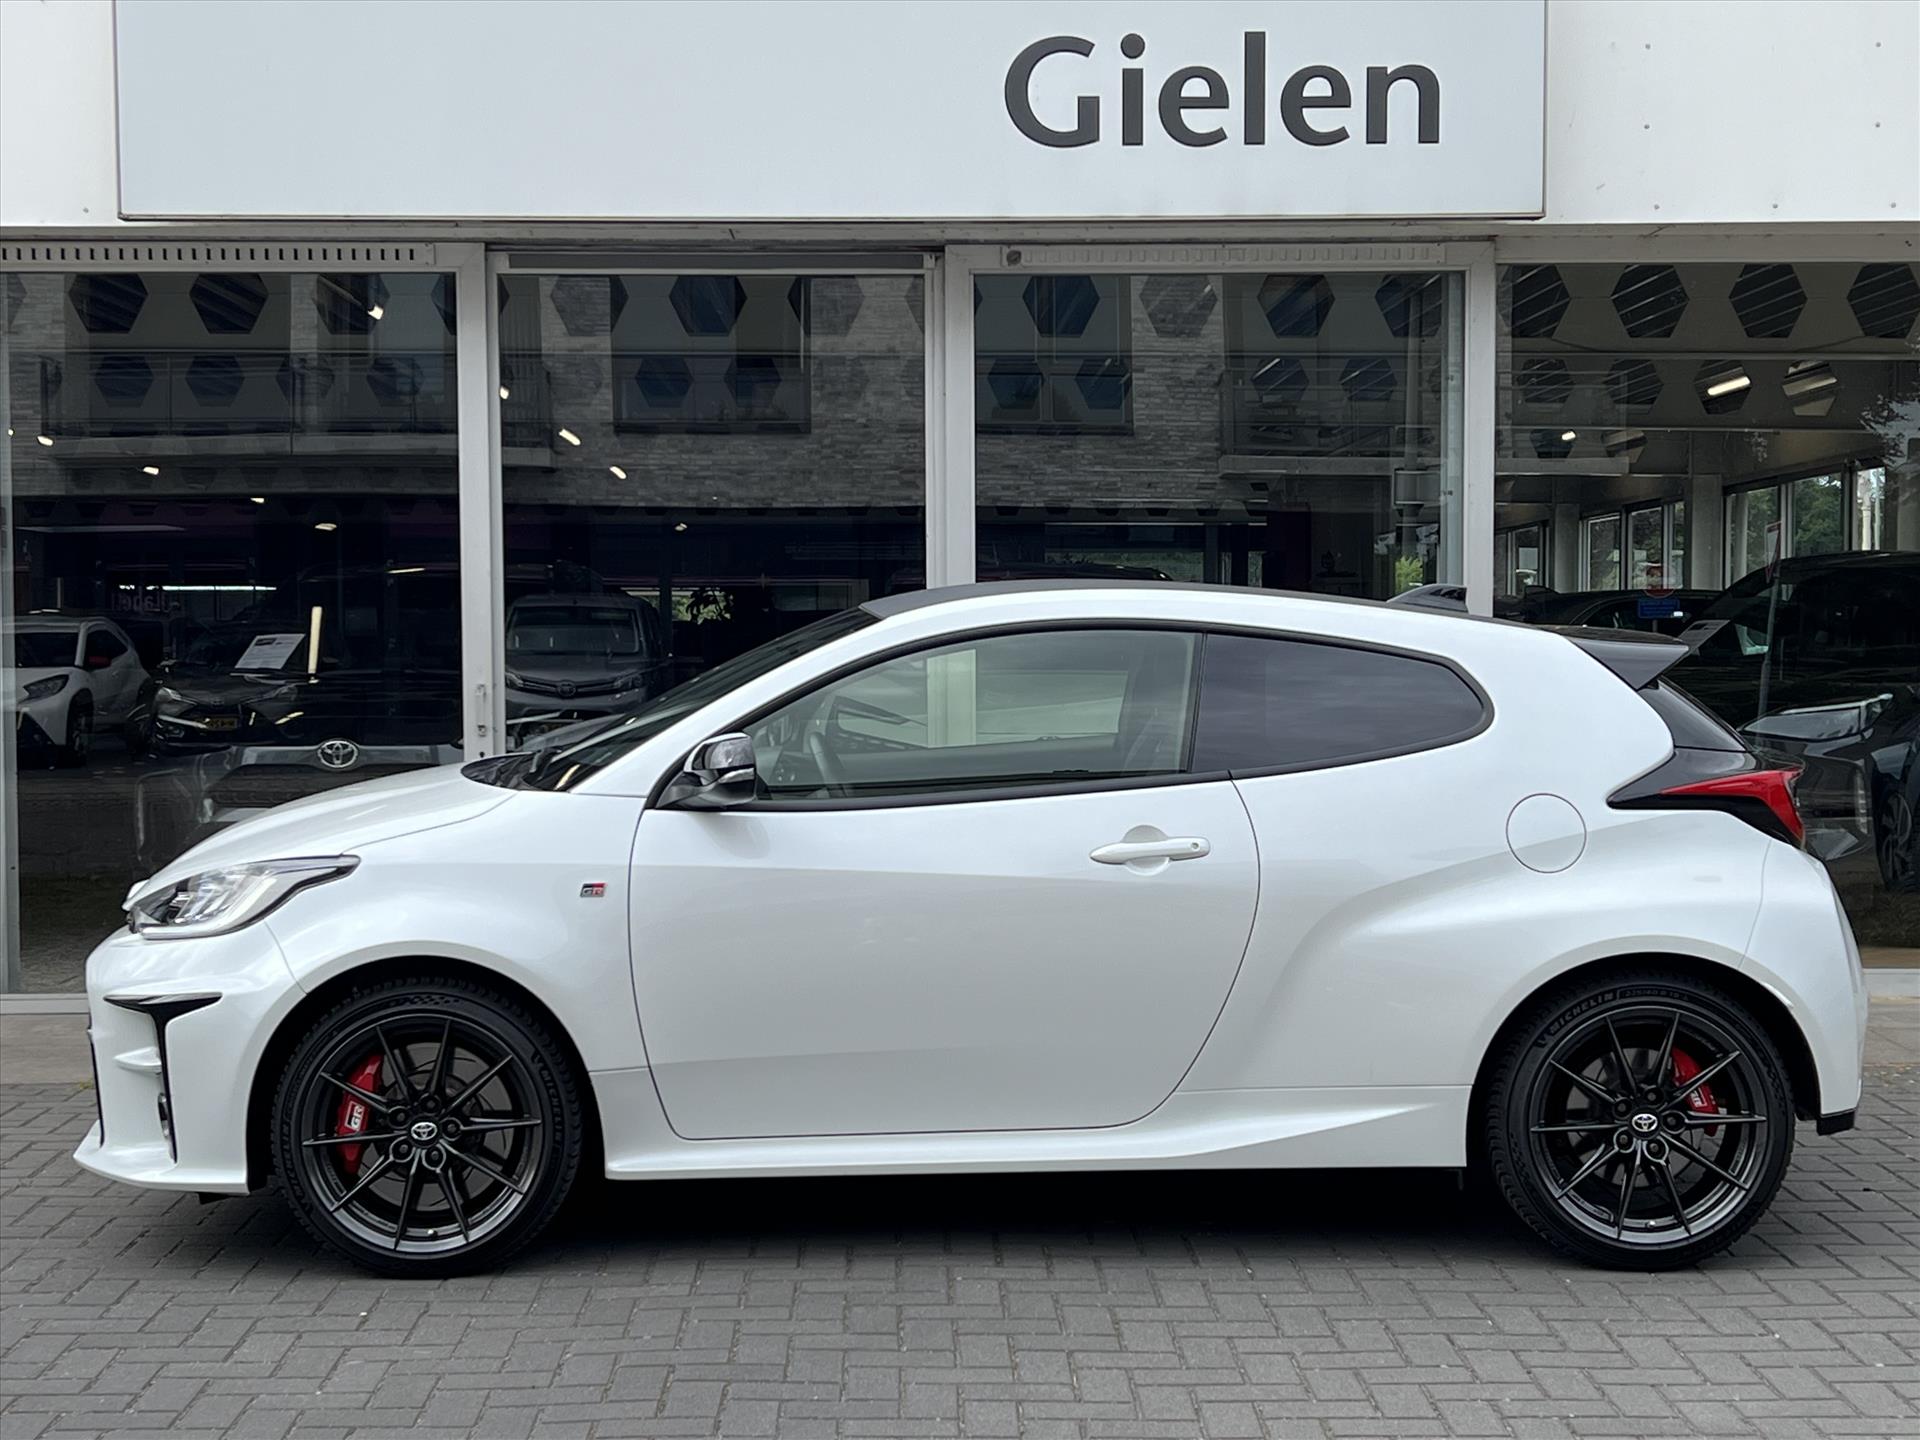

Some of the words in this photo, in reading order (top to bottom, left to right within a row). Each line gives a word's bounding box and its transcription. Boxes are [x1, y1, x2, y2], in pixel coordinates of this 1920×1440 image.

[1004, 31, 1440, 148] Gielen
[582, 886, 604, 897] GR
[1549, 990, 1615, 1034] MICHELIN
